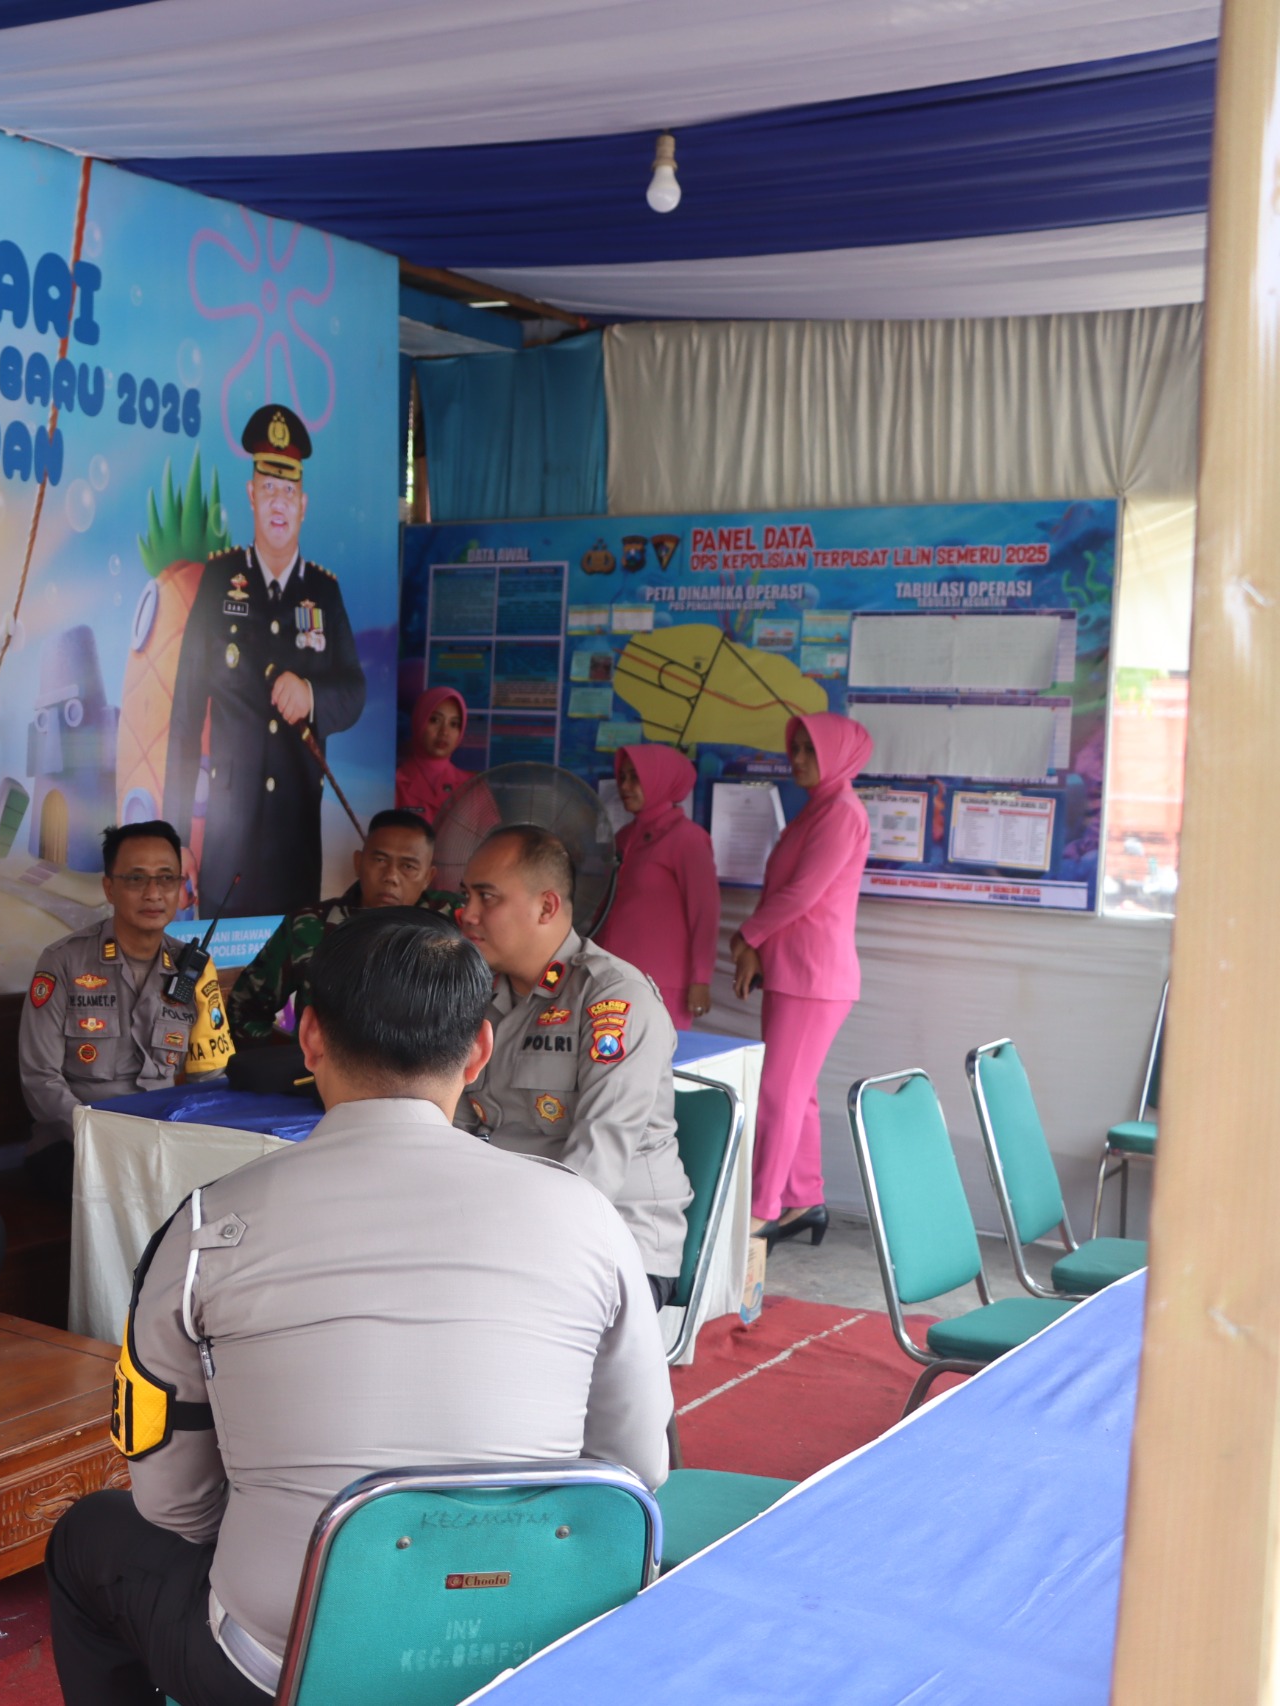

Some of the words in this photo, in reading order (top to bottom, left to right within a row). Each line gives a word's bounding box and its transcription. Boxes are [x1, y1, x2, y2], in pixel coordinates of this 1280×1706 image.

[117, 372, 201, 438] 2026
[691, 527, 756, 552] PANEL
[763, 525, 814, 550] DATA
[689, 553, 718, 571] OPS
[813, 547, 889, 568] TERPUSAT
[936, 544, 1001, 566] SEMERU
[1004, 543, 1050, 565] 2025
[645, 585, 676, 601] PETA
[678, 585, 744, 601] DINAMIKA
[746, 584, 804, 600] OPERASI
[895, 582, 965, 598] TABULASI
[968, 580, 1032, 597] OPERASI
[209, 944, 247, 957] APOLRES
[522, 1035, 572, 1052] POLRI
[465, 1574, 507, 1586] Choofu
[445, 1618, 481, 1640] INV
